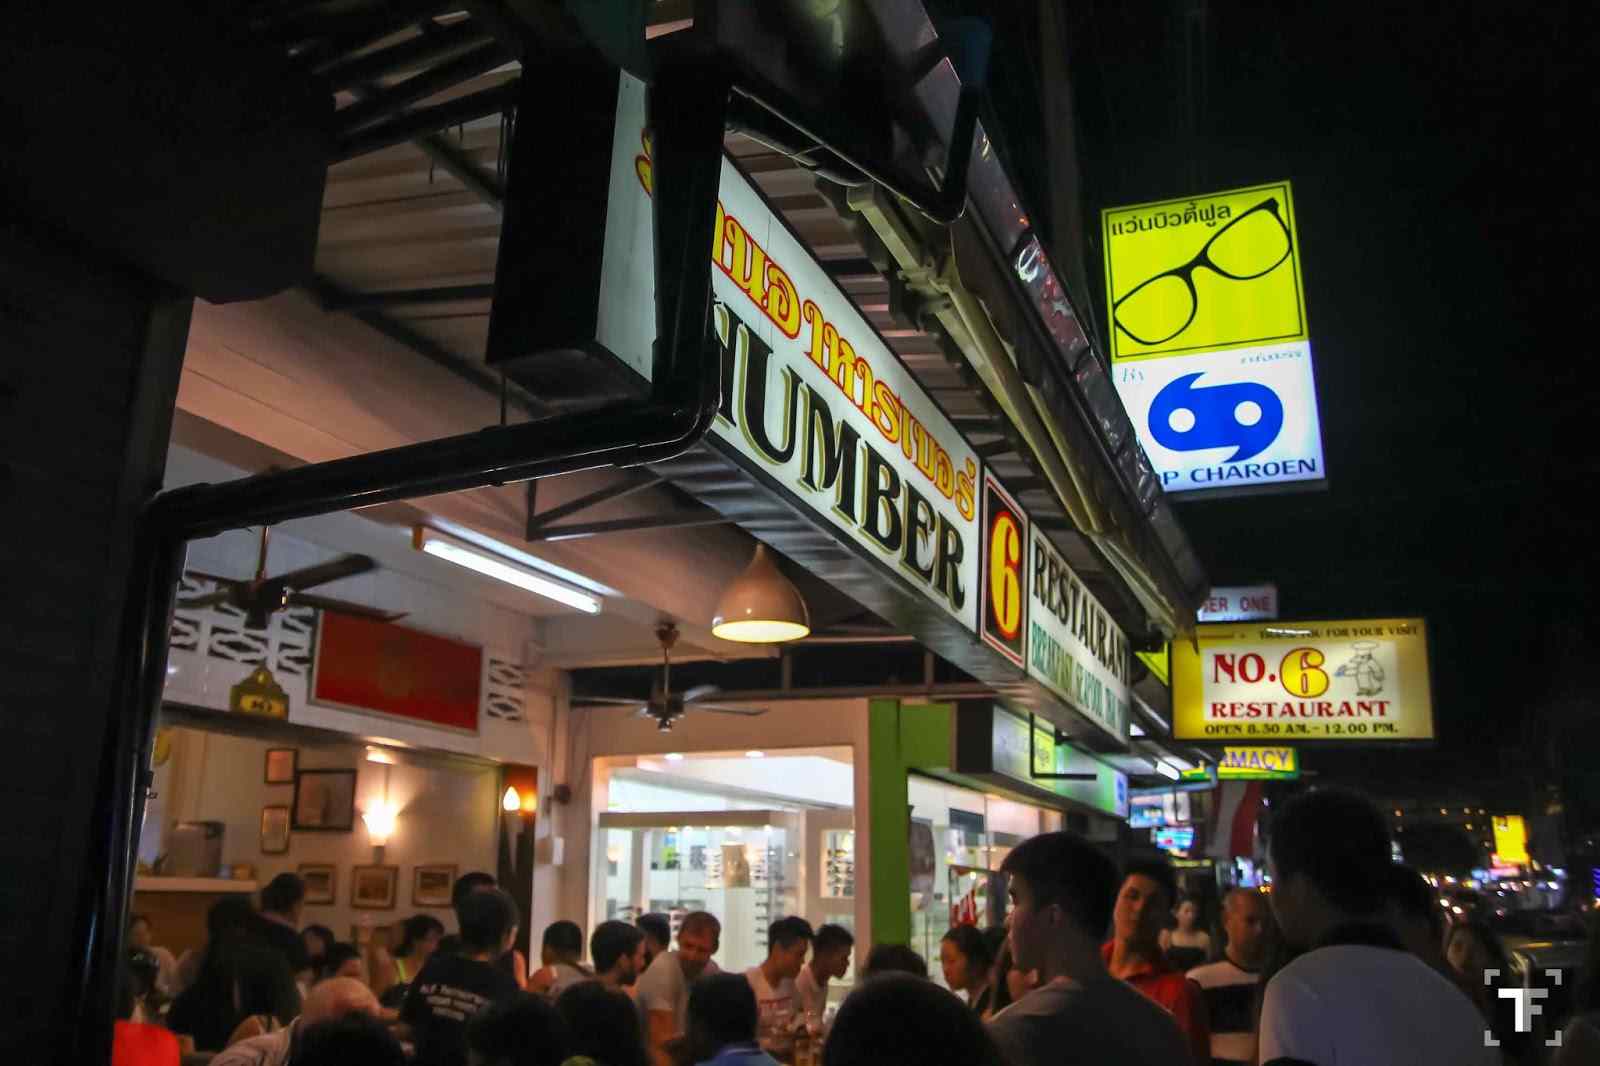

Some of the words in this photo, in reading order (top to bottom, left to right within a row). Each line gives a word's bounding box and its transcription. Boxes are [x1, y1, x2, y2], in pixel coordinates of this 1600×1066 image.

[1190, 458, 1316, 482] CHAROEN
[990, 511, 1021, 640] 6
[1211, 700, 1391, 718] RESTAURANT
[1204, 724, 1242, 735] OPEN
[1325, 722, 1367, 734] 12.00
[1373, 722, 1398, 733] PM.
